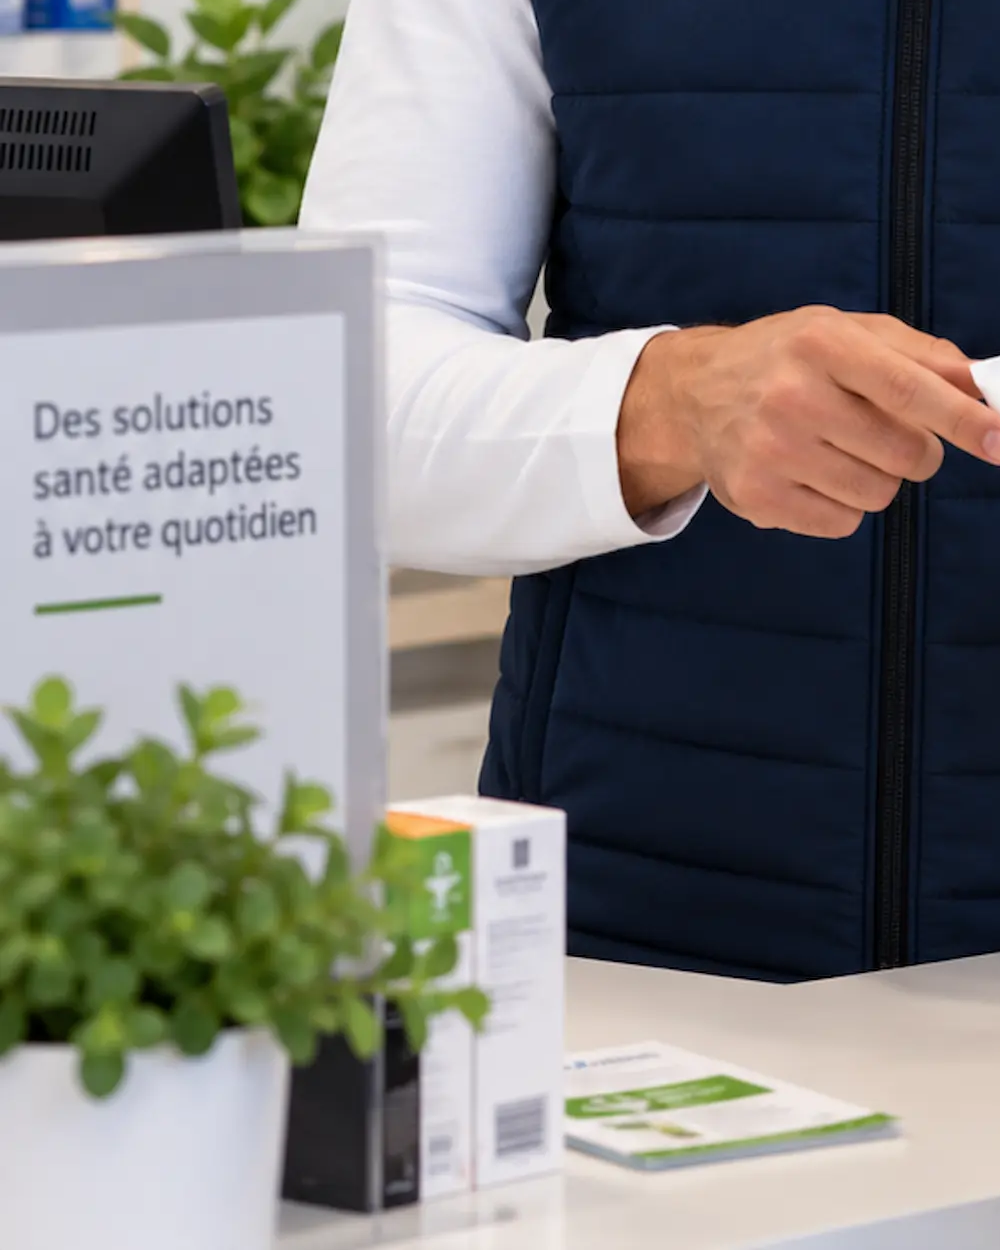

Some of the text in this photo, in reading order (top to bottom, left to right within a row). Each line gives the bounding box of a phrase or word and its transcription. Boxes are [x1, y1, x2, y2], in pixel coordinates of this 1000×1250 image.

[33, 391, 274, 441] Des solutions
[33, 445, 302, 500] santé adaptées
[33, 501, 318, 559] à votre quotidien
